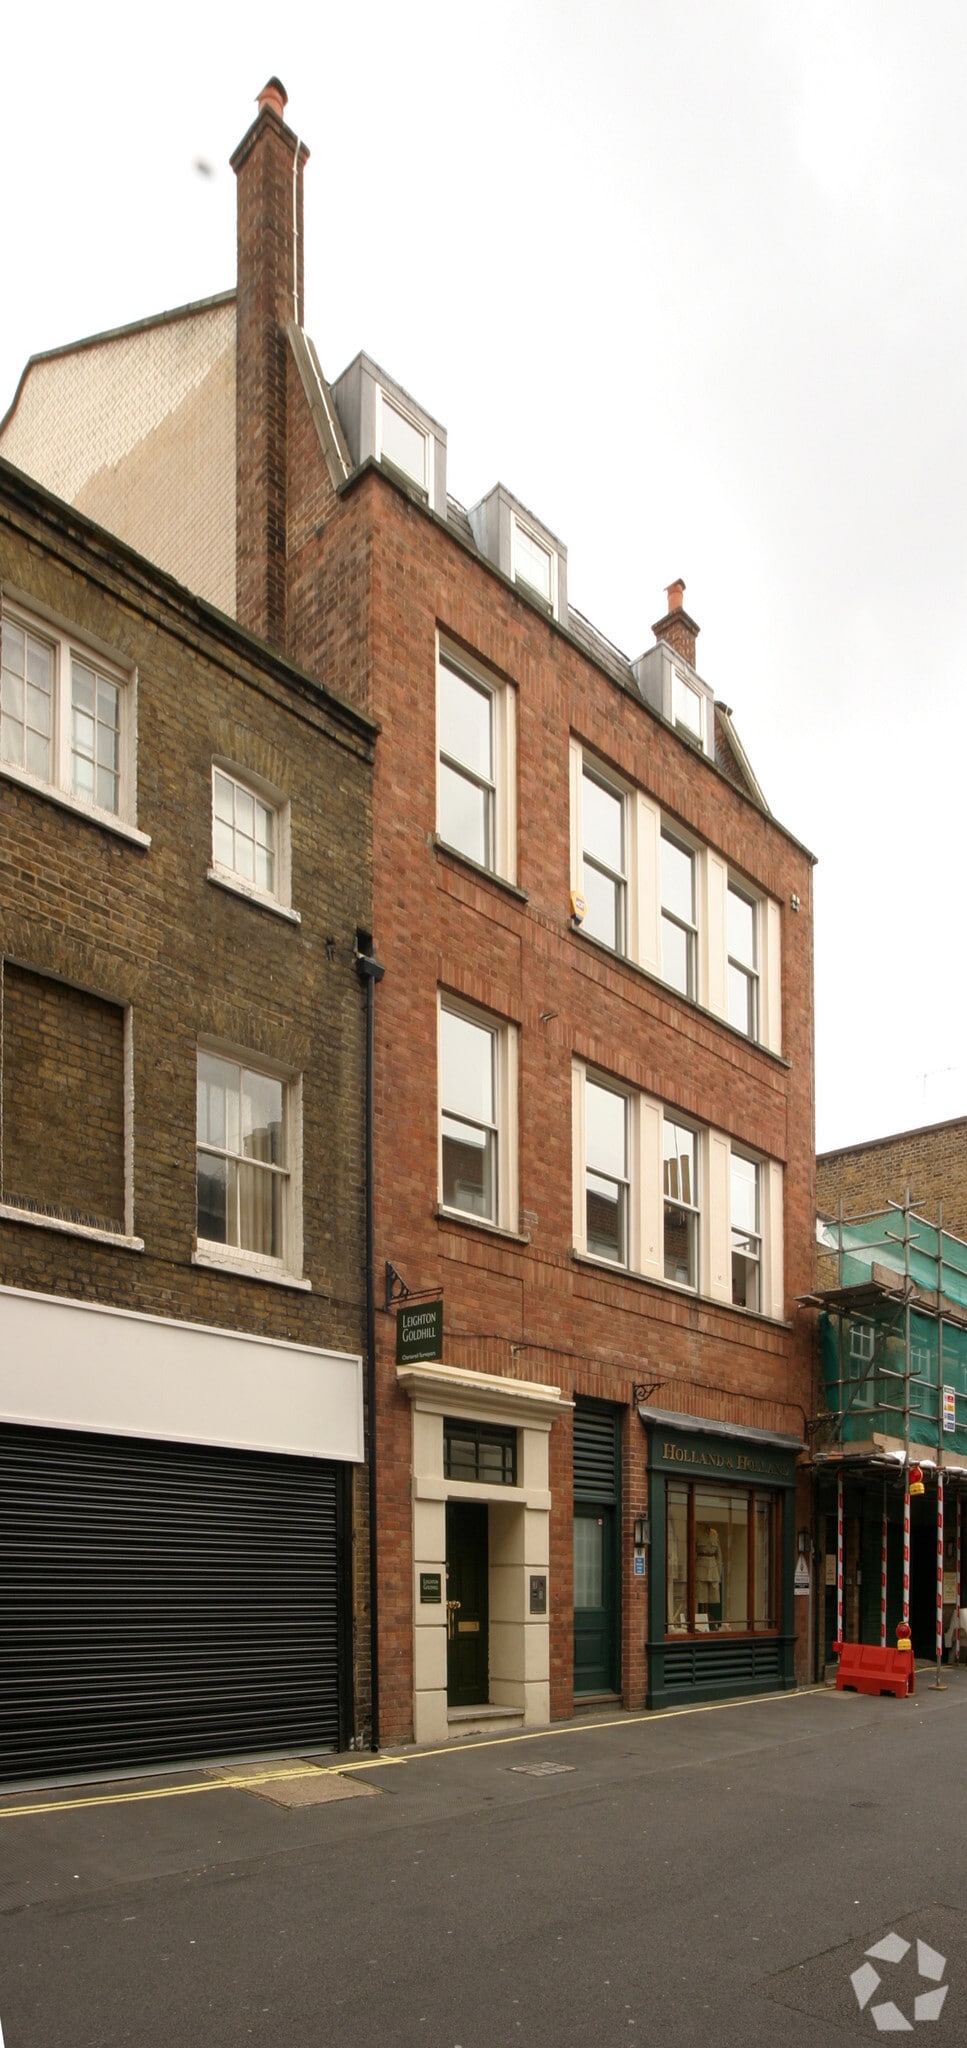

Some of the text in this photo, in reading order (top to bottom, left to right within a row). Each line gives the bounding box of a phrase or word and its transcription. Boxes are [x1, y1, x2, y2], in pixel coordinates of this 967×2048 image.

[402, 1311, 436, 1328] LEIGHTON
[402, 1327, 436, 1342] GOLDHILL
[662, 1443, 724, 1467] HOLLAND
[726, 1457, 733, 1468] &
